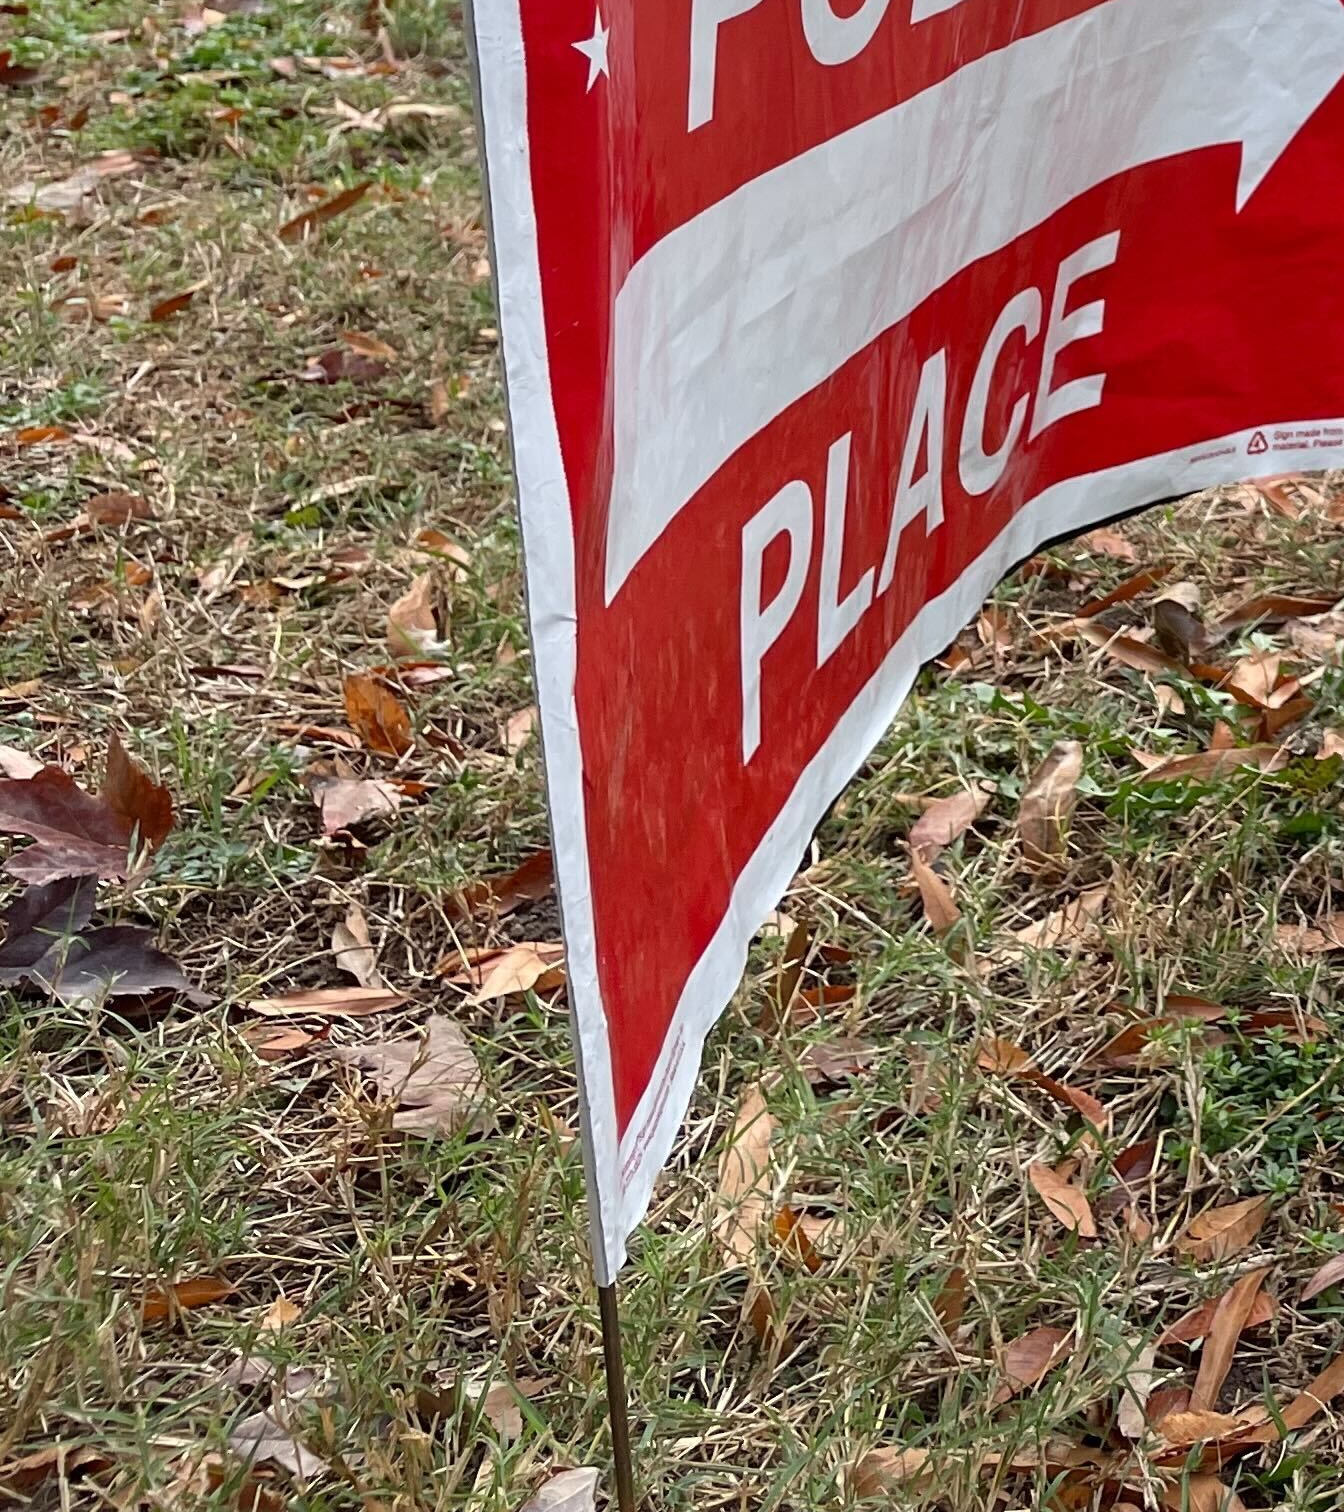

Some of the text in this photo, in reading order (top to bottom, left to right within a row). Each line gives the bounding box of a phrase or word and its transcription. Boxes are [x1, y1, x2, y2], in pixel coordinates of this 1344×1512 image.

[740, 228, 1121, 766] PLACE
[1273, 430, 1293, 441] Sign
[1295, 429, 1320, 438] made
[1323, 426, 1343, 436] from
